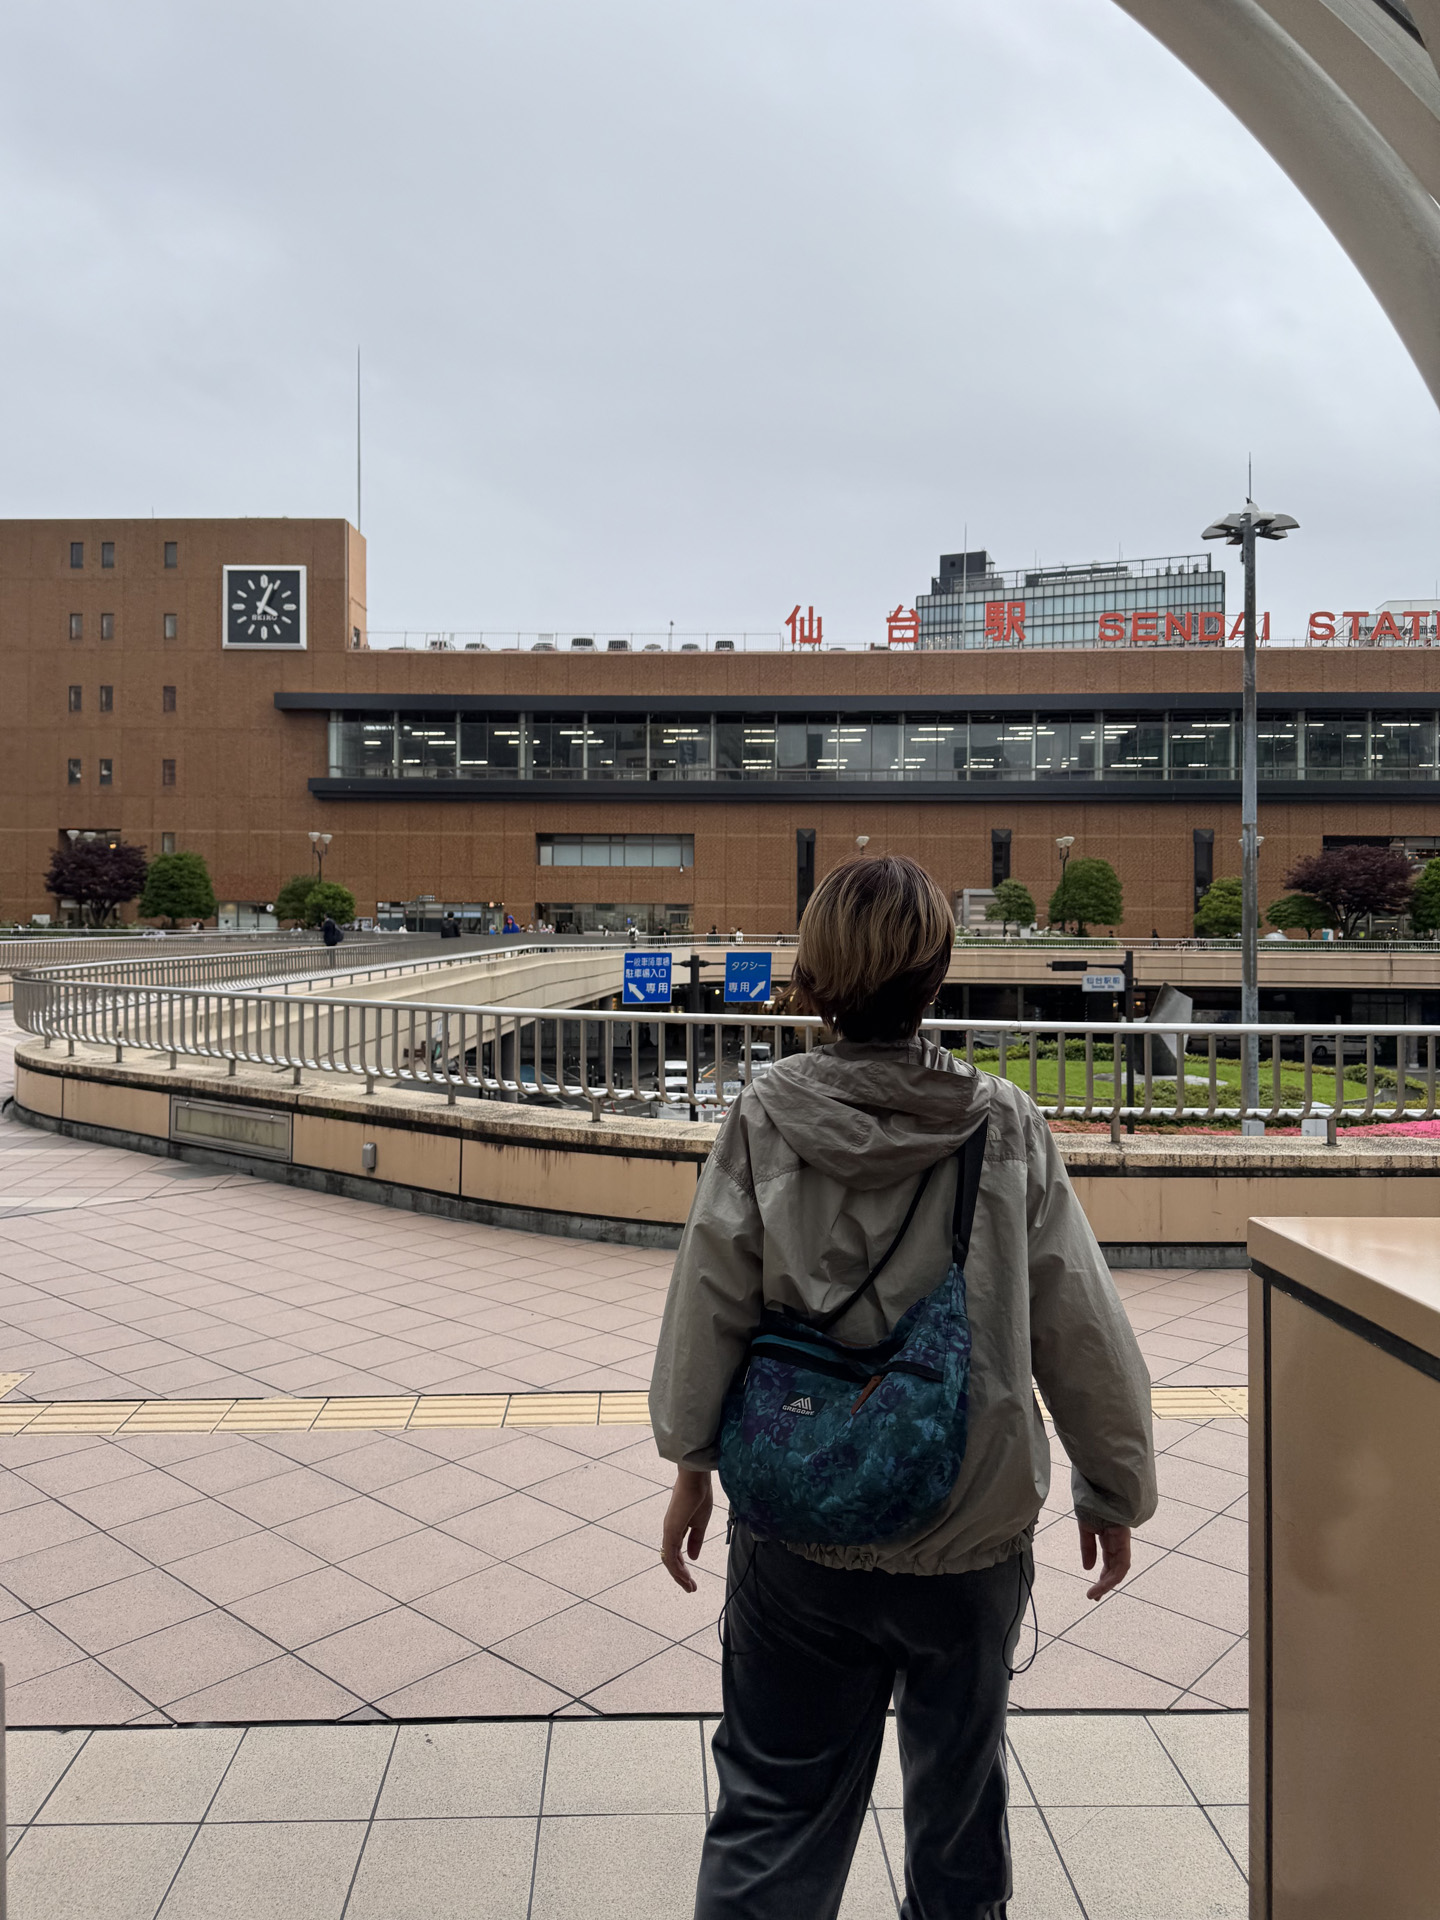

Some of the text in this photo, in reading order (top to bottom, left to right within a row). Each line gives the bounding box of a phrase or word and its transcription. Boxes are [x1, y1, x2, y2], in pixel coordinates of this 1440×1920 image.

[1098, 611, 1270, 642] SENDAI
[731, 961, 767, 971] タクシー
[625, 968, 667, 978] 駐車場入口
[645, 982, 668, 994] 専用
[728, 982, 750, 993] 専用
[782, 1404, 815, 1416] GREGORY
